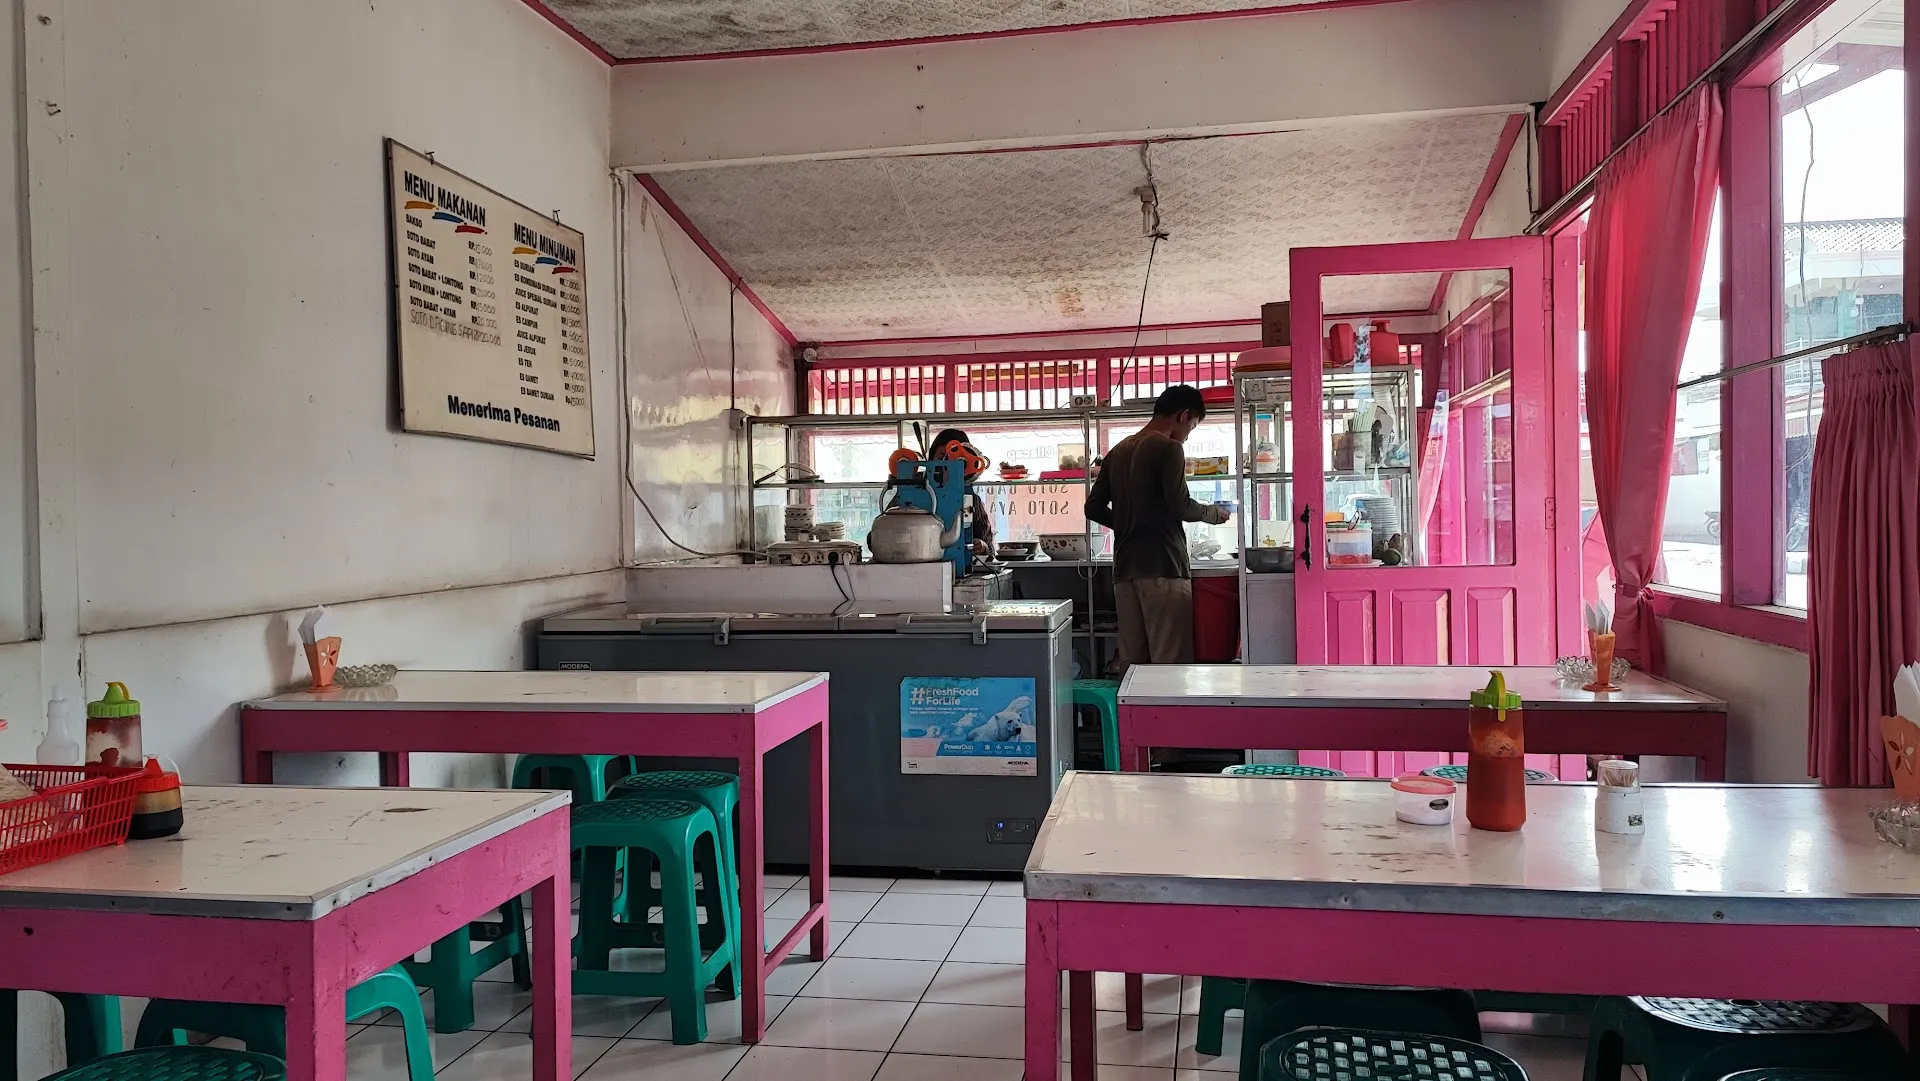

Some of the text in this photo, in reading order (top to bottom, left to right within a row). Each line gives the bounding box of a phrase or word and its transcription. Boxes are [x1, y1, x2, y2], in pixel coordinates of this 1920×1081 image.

[404, 170, 486, 227] MENU MAKANAN
[406, 213, 423, 229] BAKSO
[406, 230, 420, 243] SOTO
[420, 235, 435, 249] BABAT
[514, 222, 576, 266] MENU MINUMAN
[407, 246, 420, 259] SOTO
[421, 251, 434, 264] AYAM
[514, 259, 520, 268] ES
[520, 261, 535, 274] DURIAN
[408, 262, 421, 275] SOTO
[421, 267, 437, 281] BABAT
[441, 274, 464, 290] LONTONG
[514, 273, 520, 282] ES
[542, 283, 556, 295] DURIAN
[409, 278, 421, 291] SOTO
[422, 283, 435, 296] AYAM
[440, 289, 462, 304] LONTONG
[515, 287, 527, 298] JUICE
[543, 297, 557, 309] DURIAN
[410, 295, 422, 308] SOTO
[423, 299, 438, 312] BABAT
[443, 306, 456, 318] AYAM
[515, 301, 521, 310] ES
[521, 303, 539, 316] ALPUKAT
[410, 308, 427, 326] SOTO
[515, 315, 521, 324] ES
[521, 317, 538, 329] CAMPUR
[517, 329, 528, 340] JUICE
[529, 333, 546, 345] ALPUKAT
[517, 343, 523, 352] ES
[524, 345, 536, 356] JERUK
[518, 357, 523, 366] ES
[524, 358, 532, 368] TEH
[519, 372, 525, 381] ES
[520, 386, 526, 395] ES
[540, 390, 554, 401] DURIAN
[447, 394, 561, 432] Menerima Pesanan
[926, 697, 961, 705] ForLife
